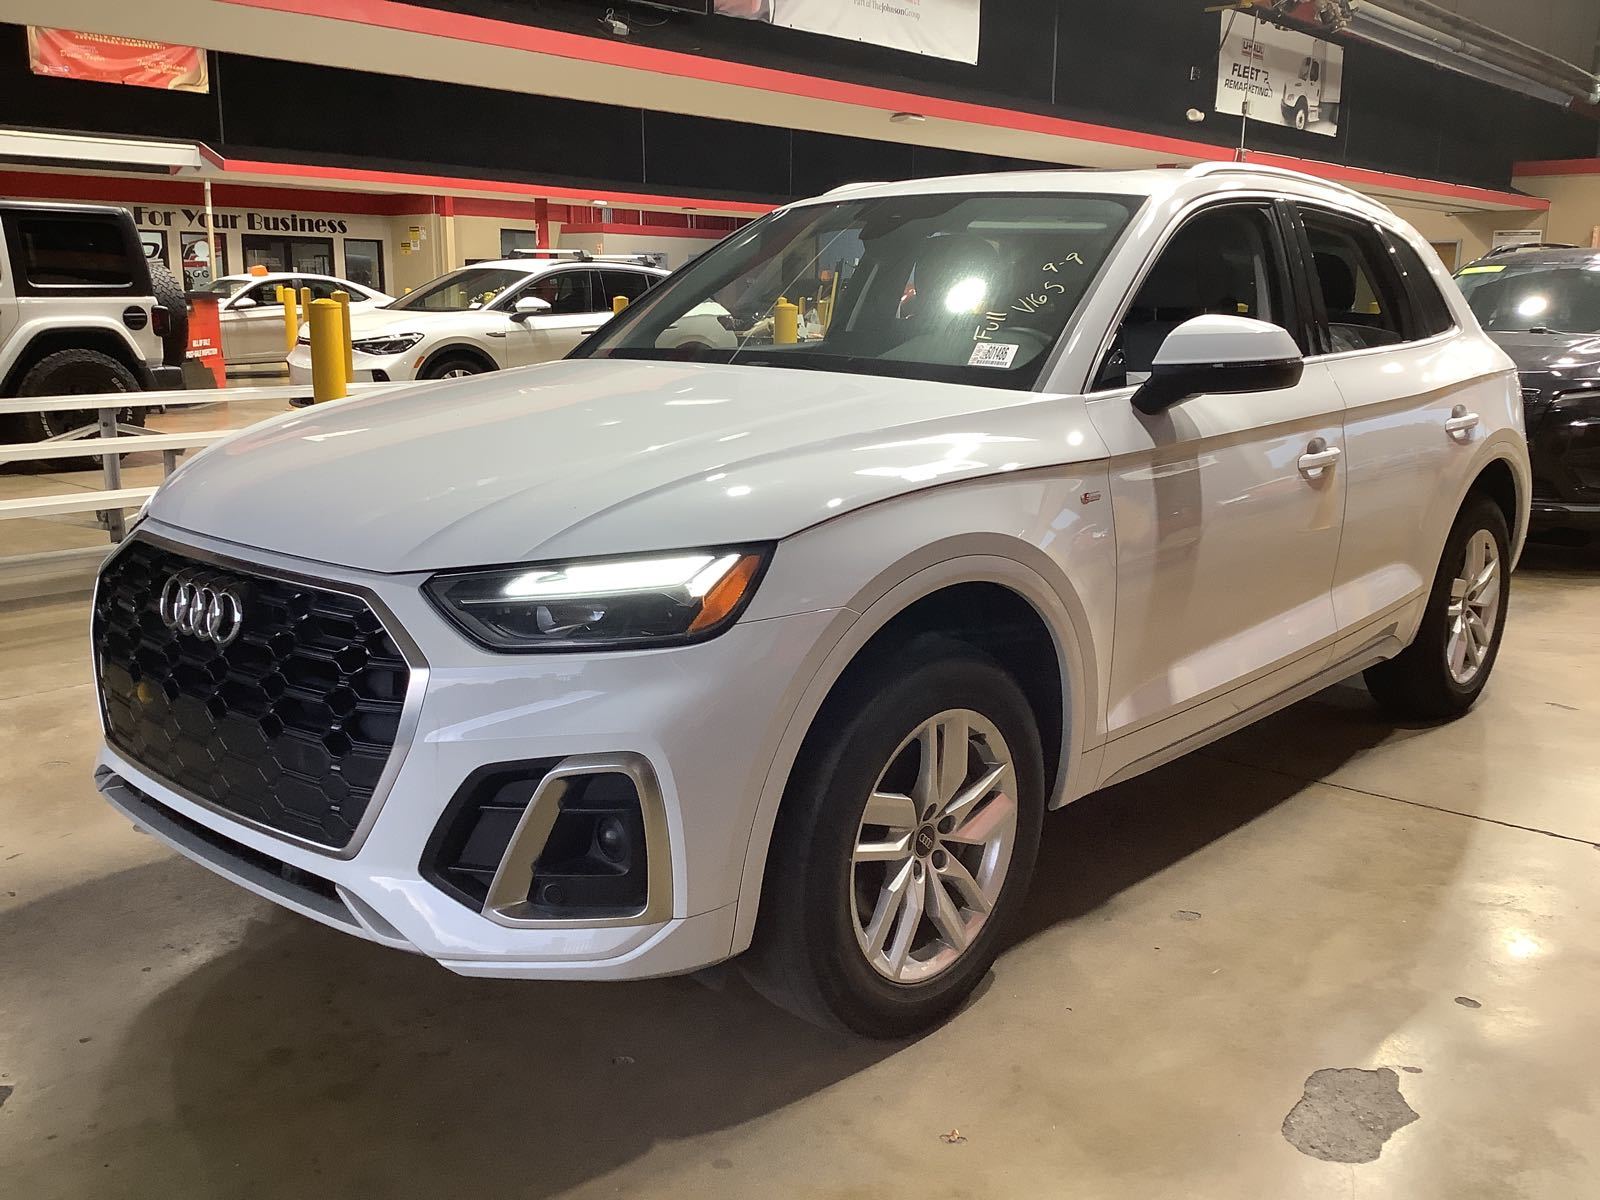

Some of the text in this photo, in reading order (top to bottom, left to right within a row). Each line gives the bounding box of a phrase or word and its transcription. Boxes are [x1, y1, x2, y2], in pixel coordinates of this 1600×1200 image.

[1231, 63, 1260, 81] FLEET
[133, 206, 348, 234] For Your Business
[973, 311, 1008, 342] Full
